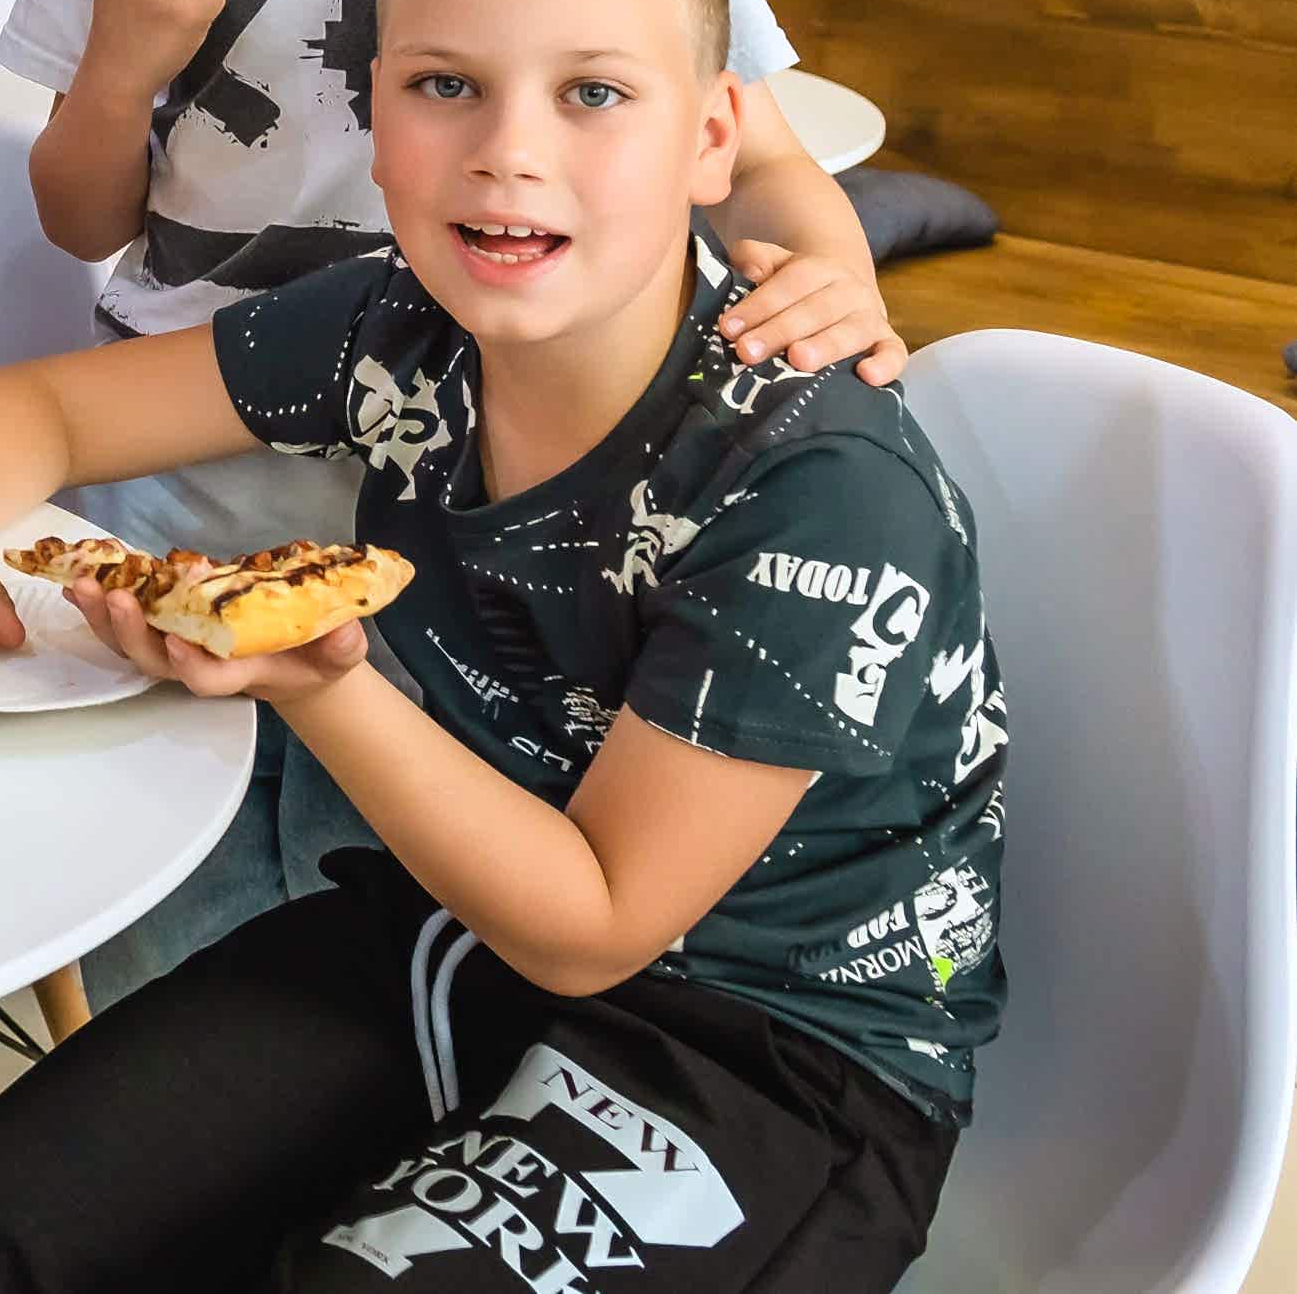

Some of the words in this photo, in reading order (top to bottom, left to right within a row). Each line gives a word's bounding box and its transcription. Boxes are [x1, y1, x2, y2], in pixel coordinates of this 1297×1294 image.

[746, 551, 872, 606] TODAY
[542, 1065, 704, 1177] NEW
[428, 1130, 646, 1270] NEW
